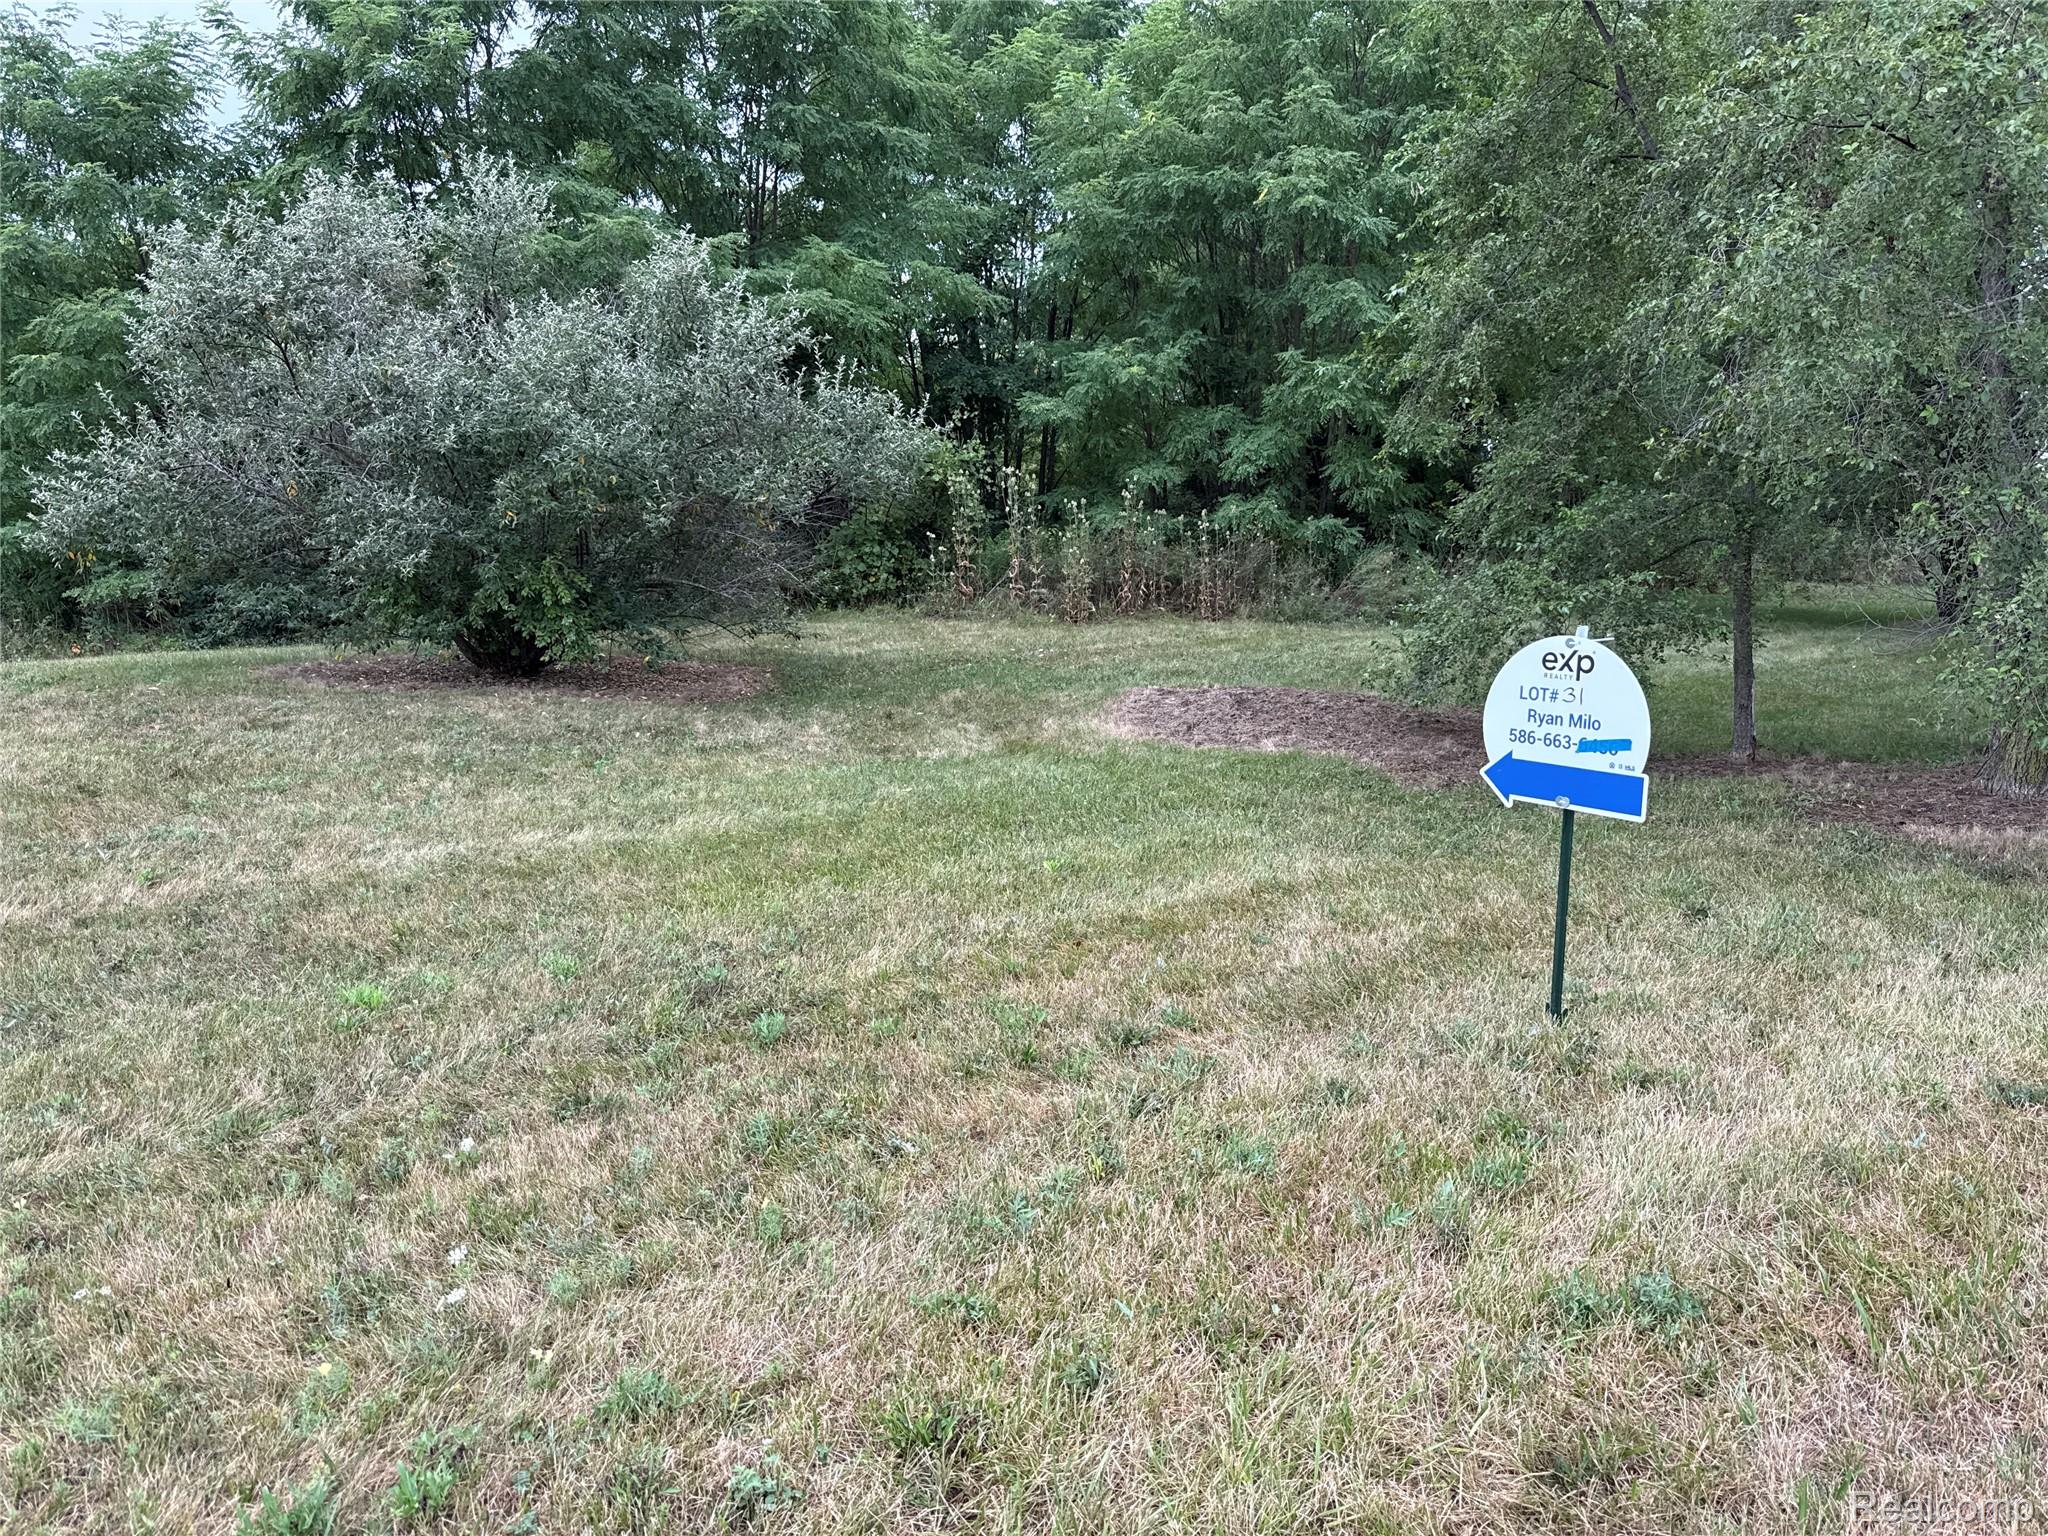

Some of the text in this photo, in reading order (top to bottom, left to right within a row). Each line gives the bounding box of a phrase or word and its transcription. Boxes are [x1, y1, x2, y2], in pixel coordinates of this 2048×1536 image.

[1543, 672, 1575, 680] REALTY
[1527, 708, 1601, 731] Ryan Milo
